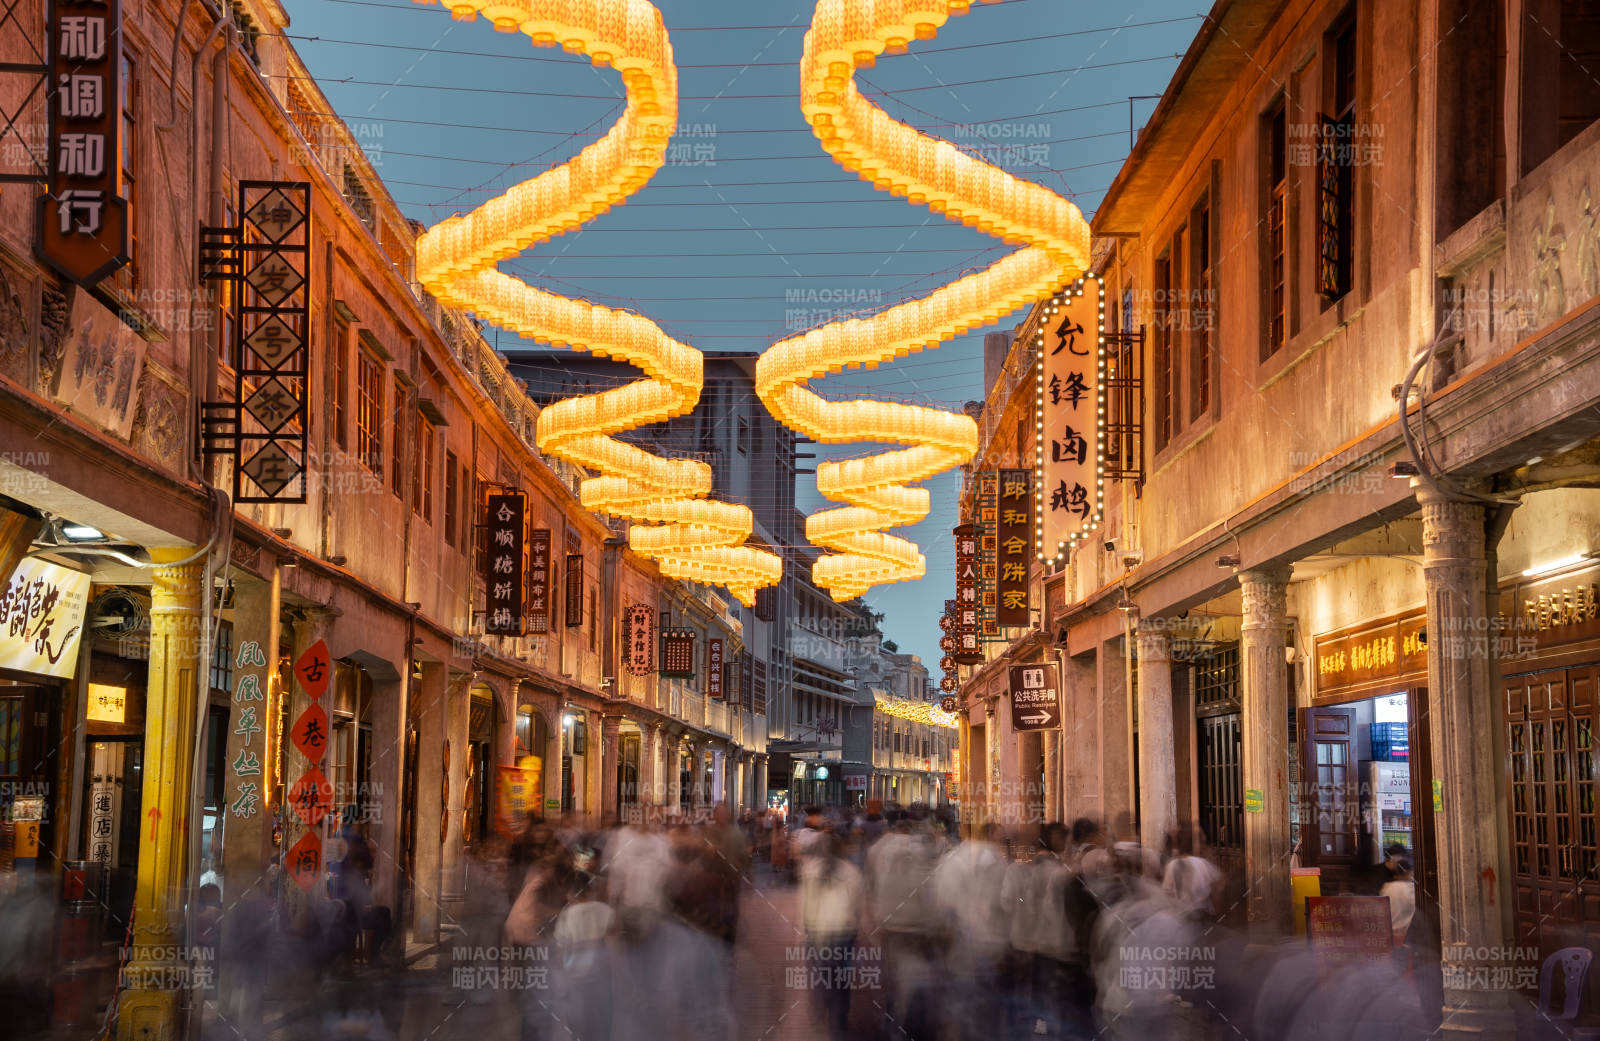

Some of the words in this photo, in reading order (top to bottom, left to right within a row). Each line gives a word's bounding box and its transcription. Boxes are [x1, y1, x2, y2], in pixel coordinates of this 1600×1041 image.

[58, 0, 105, 235] 和调和行
[254, 201, 293, 484] 坤发号茶庄
[1049, 315, 1091, 521] 允锋卤鹅
[1002, 481, 1028, 610] 邱和合饼家
[1014, 689, 1056, 702] 公共洗手间
[94, 795, 112, 871] 進店暴
